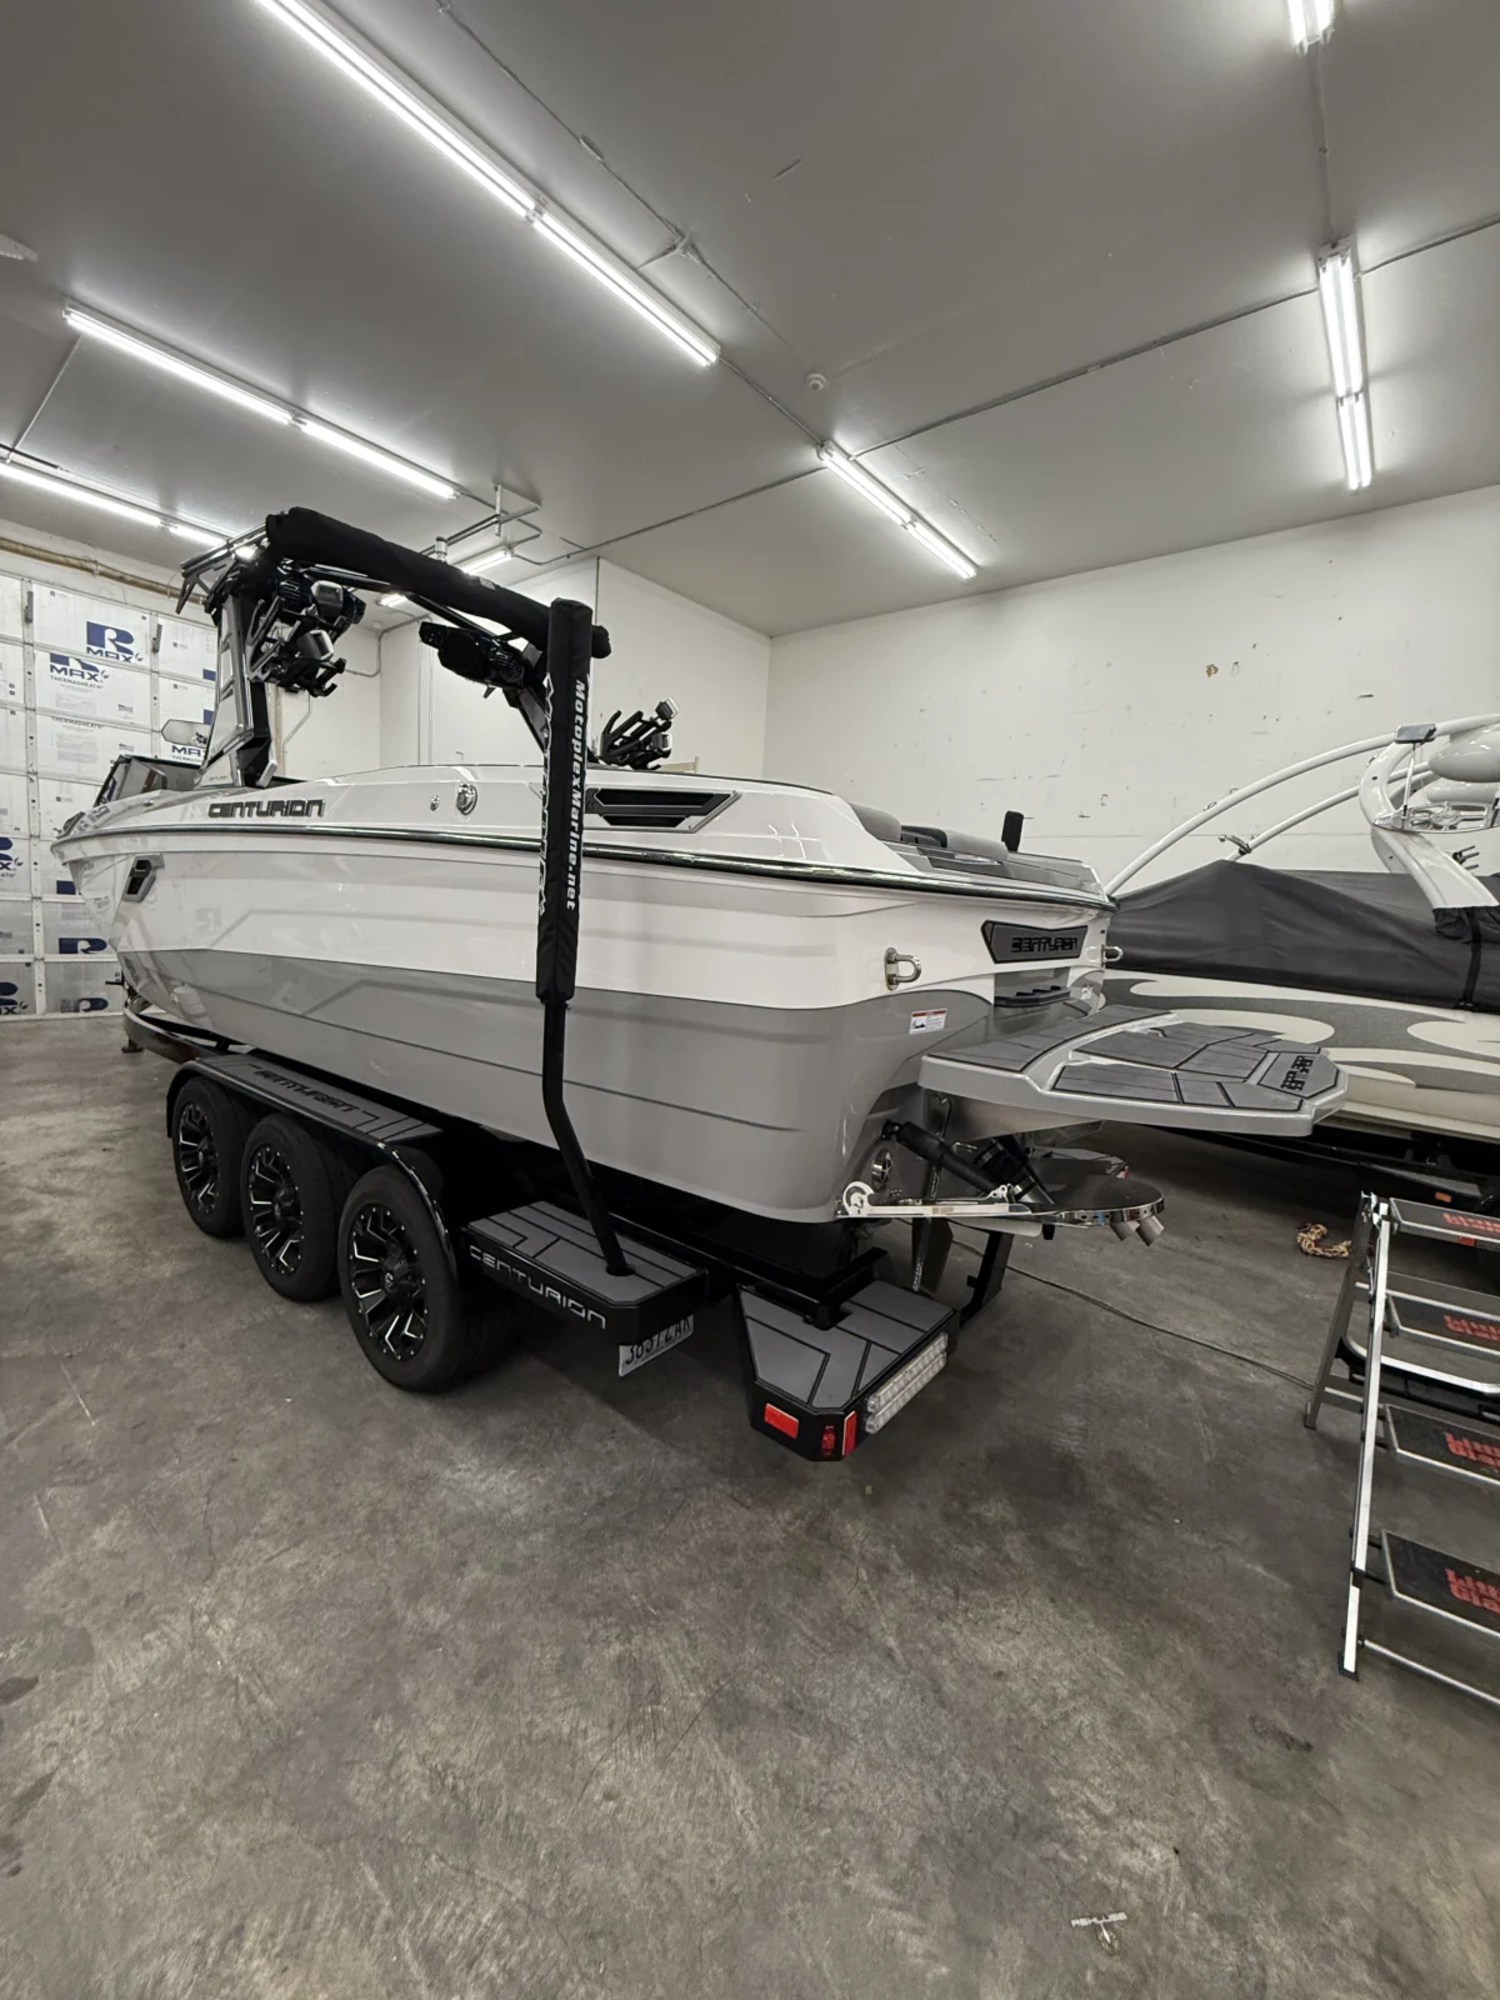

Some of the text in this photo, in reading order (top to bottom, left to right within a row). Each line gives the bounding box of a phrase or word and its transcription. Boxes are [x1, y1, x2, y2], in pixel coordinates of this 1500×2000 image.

[86, 646, 133, 664] MAX
[50, 664, 99, 682] MAX
[172, 744, 205, 757] MA
[208, 799, 325, 818] CENTURION
[469, 1244, 606, 1330] CENTURION
